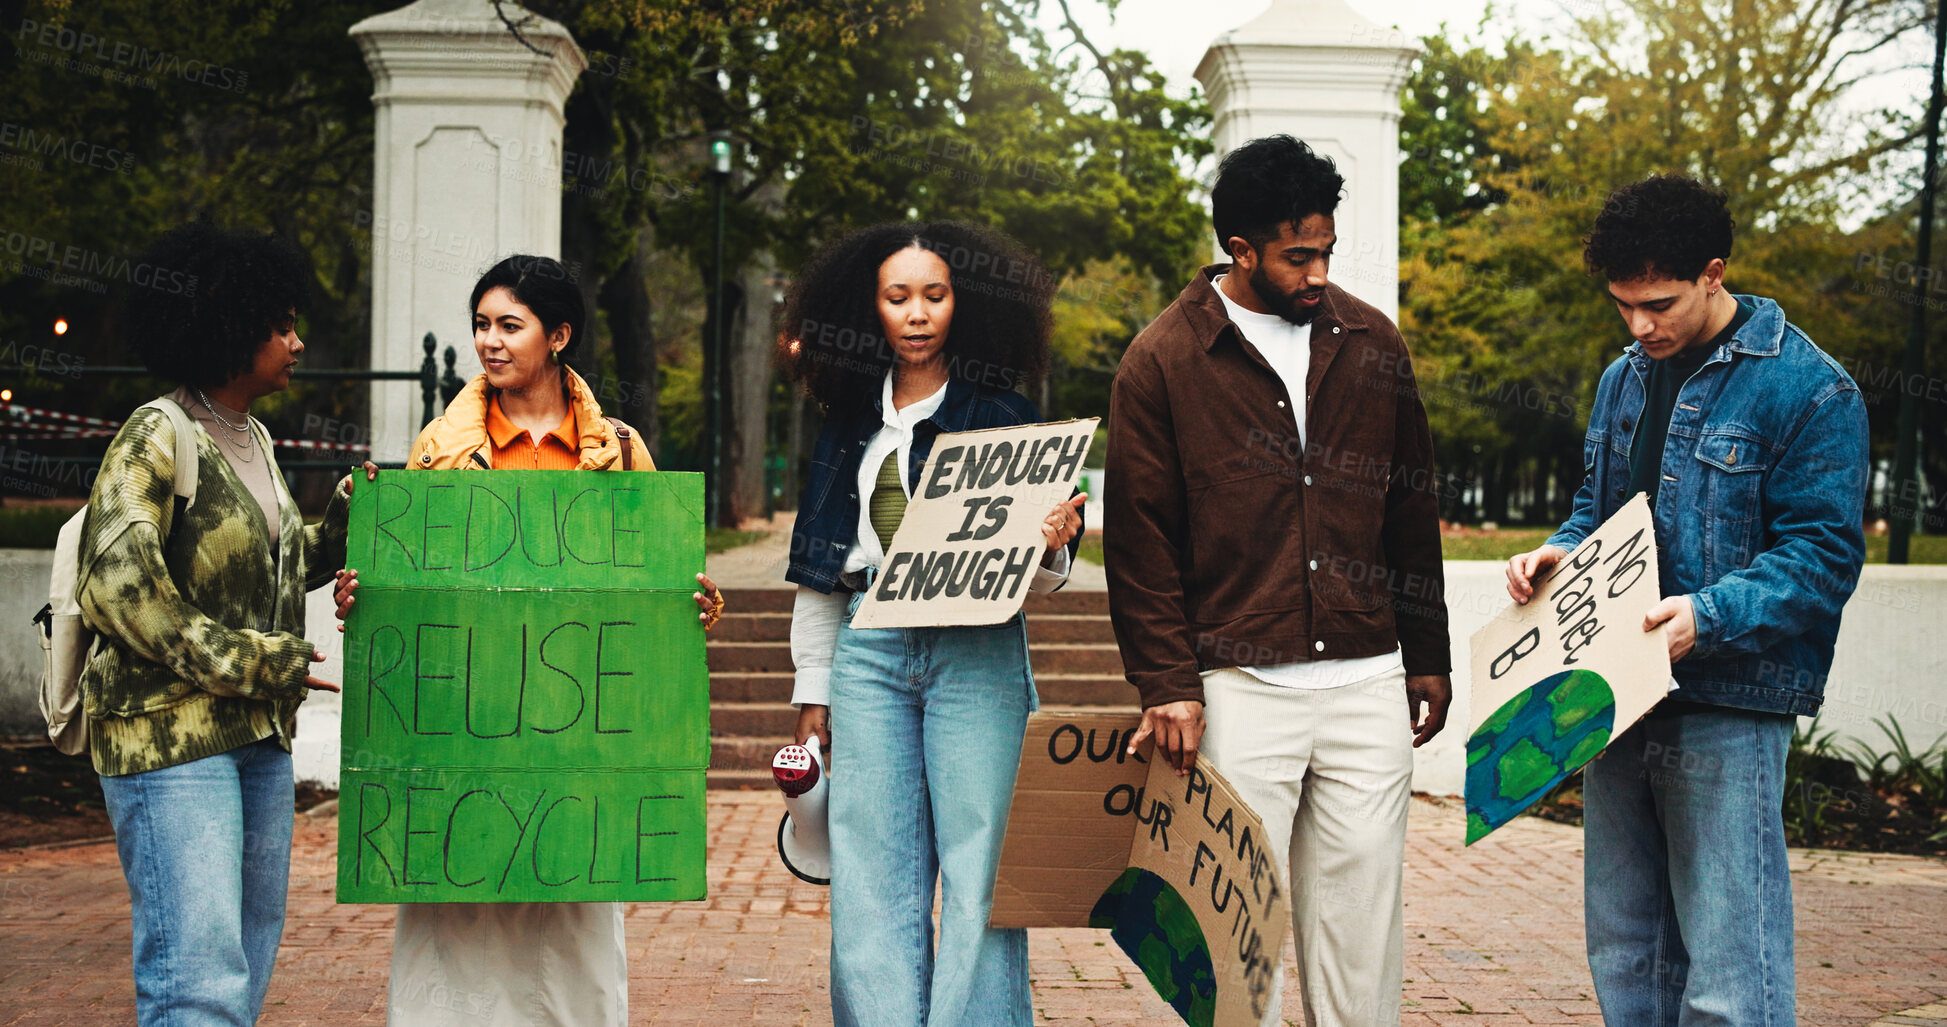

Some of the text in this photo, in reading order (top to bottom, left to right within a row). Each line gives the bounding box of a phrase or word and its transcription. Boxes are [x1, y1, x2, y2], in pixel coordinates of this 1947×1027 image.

[924, 434, 1089, 499] ENOUGH
[373, 484, 646, 572] REDUCE
[946, 495, 1013, 542] IS
[876, 546, 1035, 601] ENOUGH
[1603, 528, 1649, 598] NO
[366, 621, 636, 739] REUSE
[1490, 626, 1540, 680] B
[356, 782, 685, 895] RECYCLE
[1048, 724, 1147, 764] OUR
[1184, 767, 1280, 921] PLANET
[1103, 784, 1172, 851] OUR
